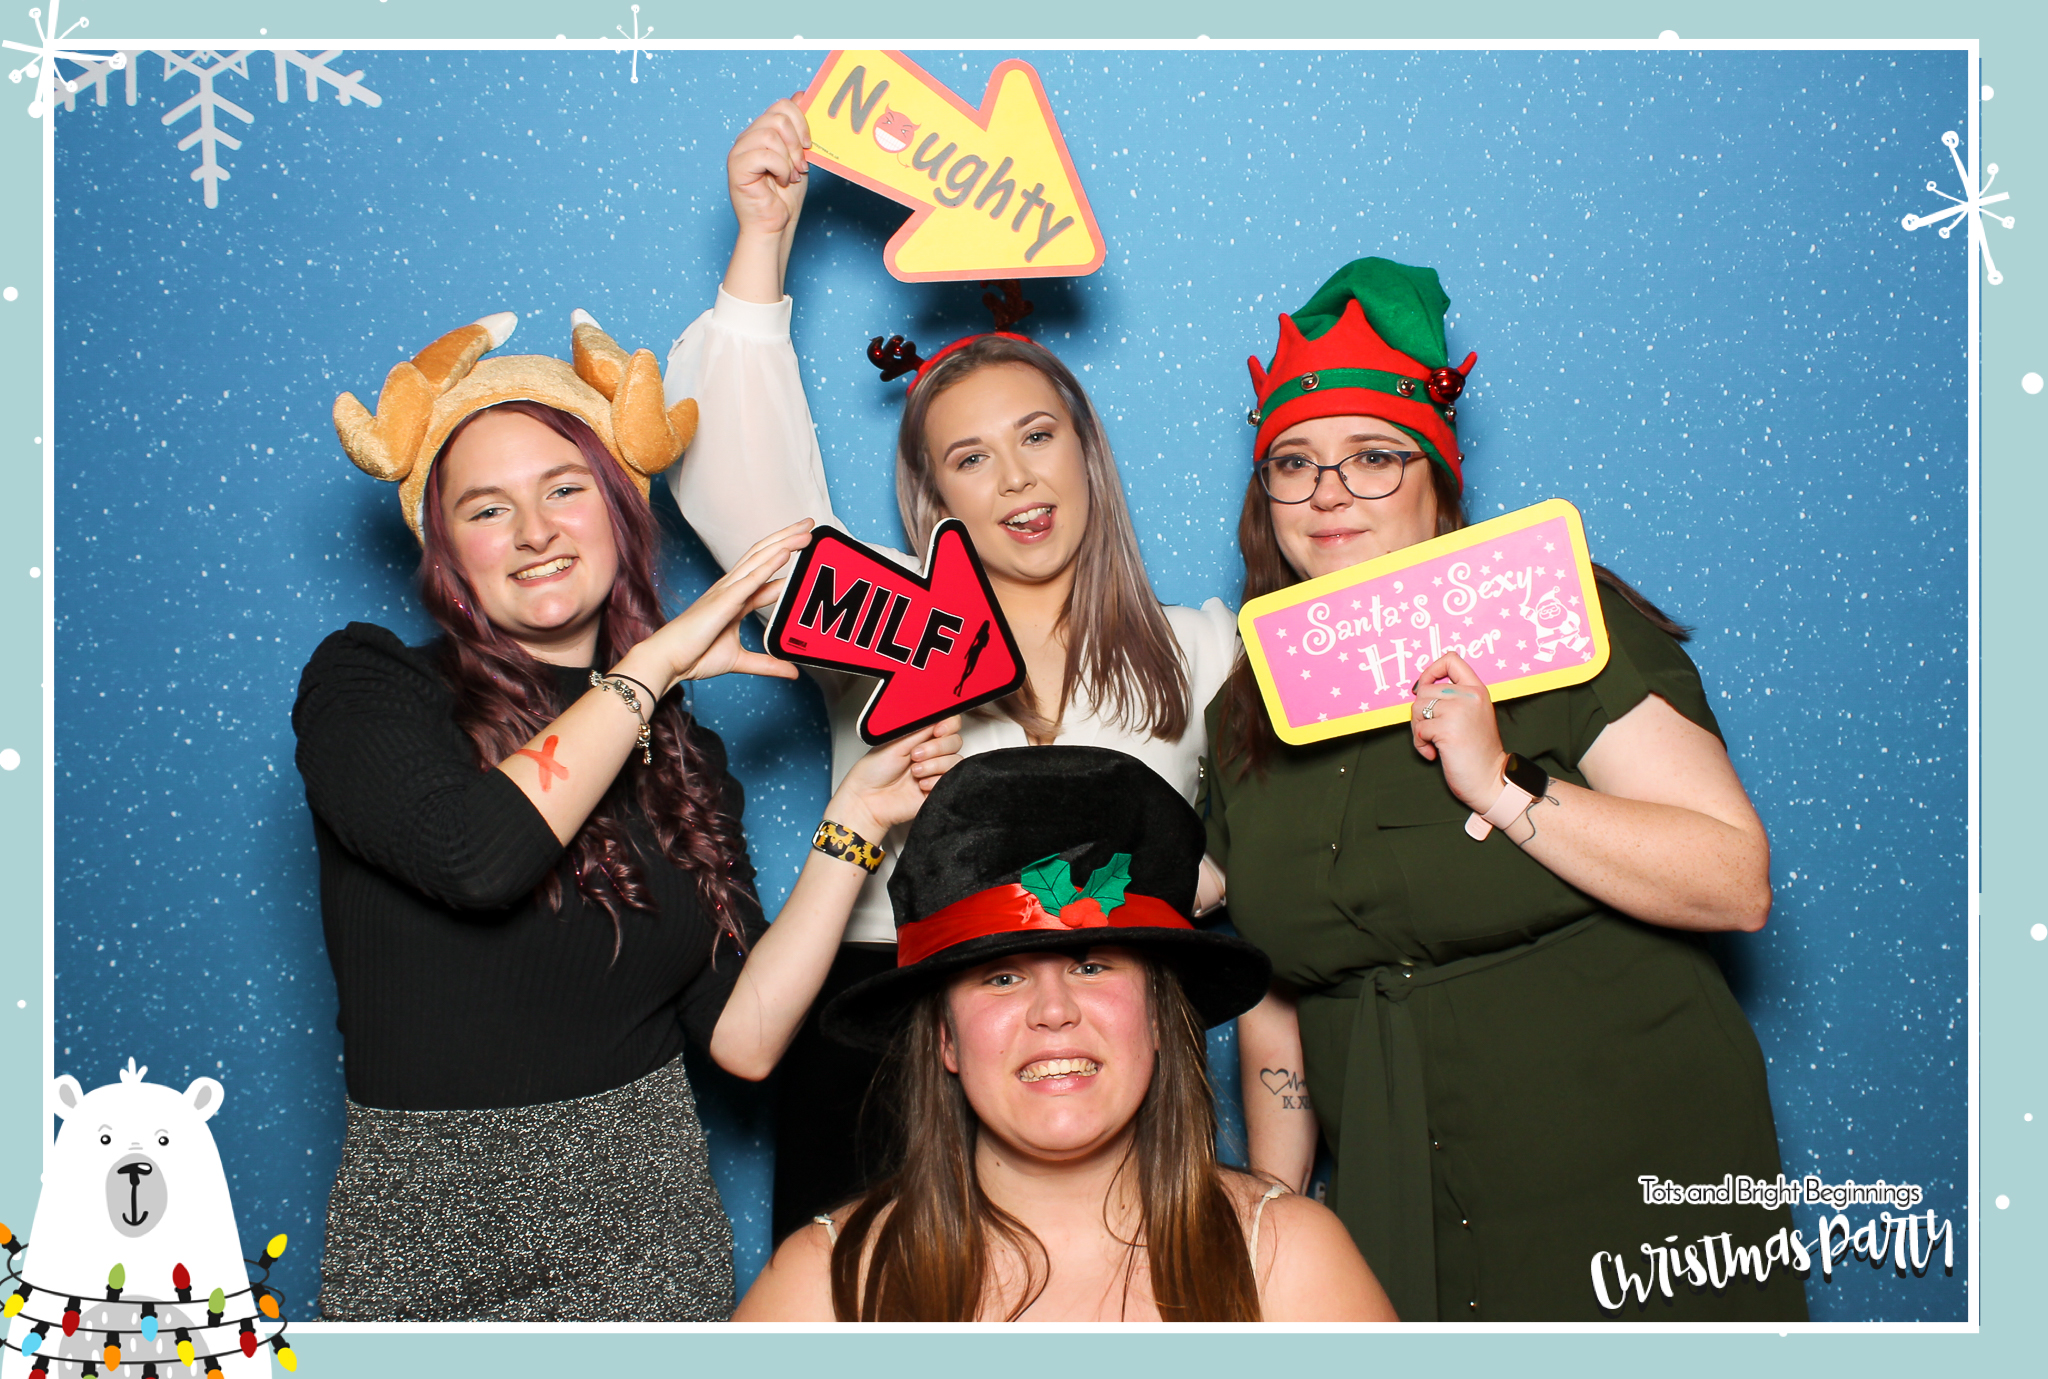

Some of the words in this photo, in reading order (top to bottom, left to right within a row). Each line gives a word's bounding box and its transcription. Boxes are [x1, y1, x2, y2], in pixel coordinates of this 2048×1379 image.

[798, 563, 964, 670] MILF
[1302, 580, 1430, 656] Santa's
[1442, 562, 1533, 616] Sexy
